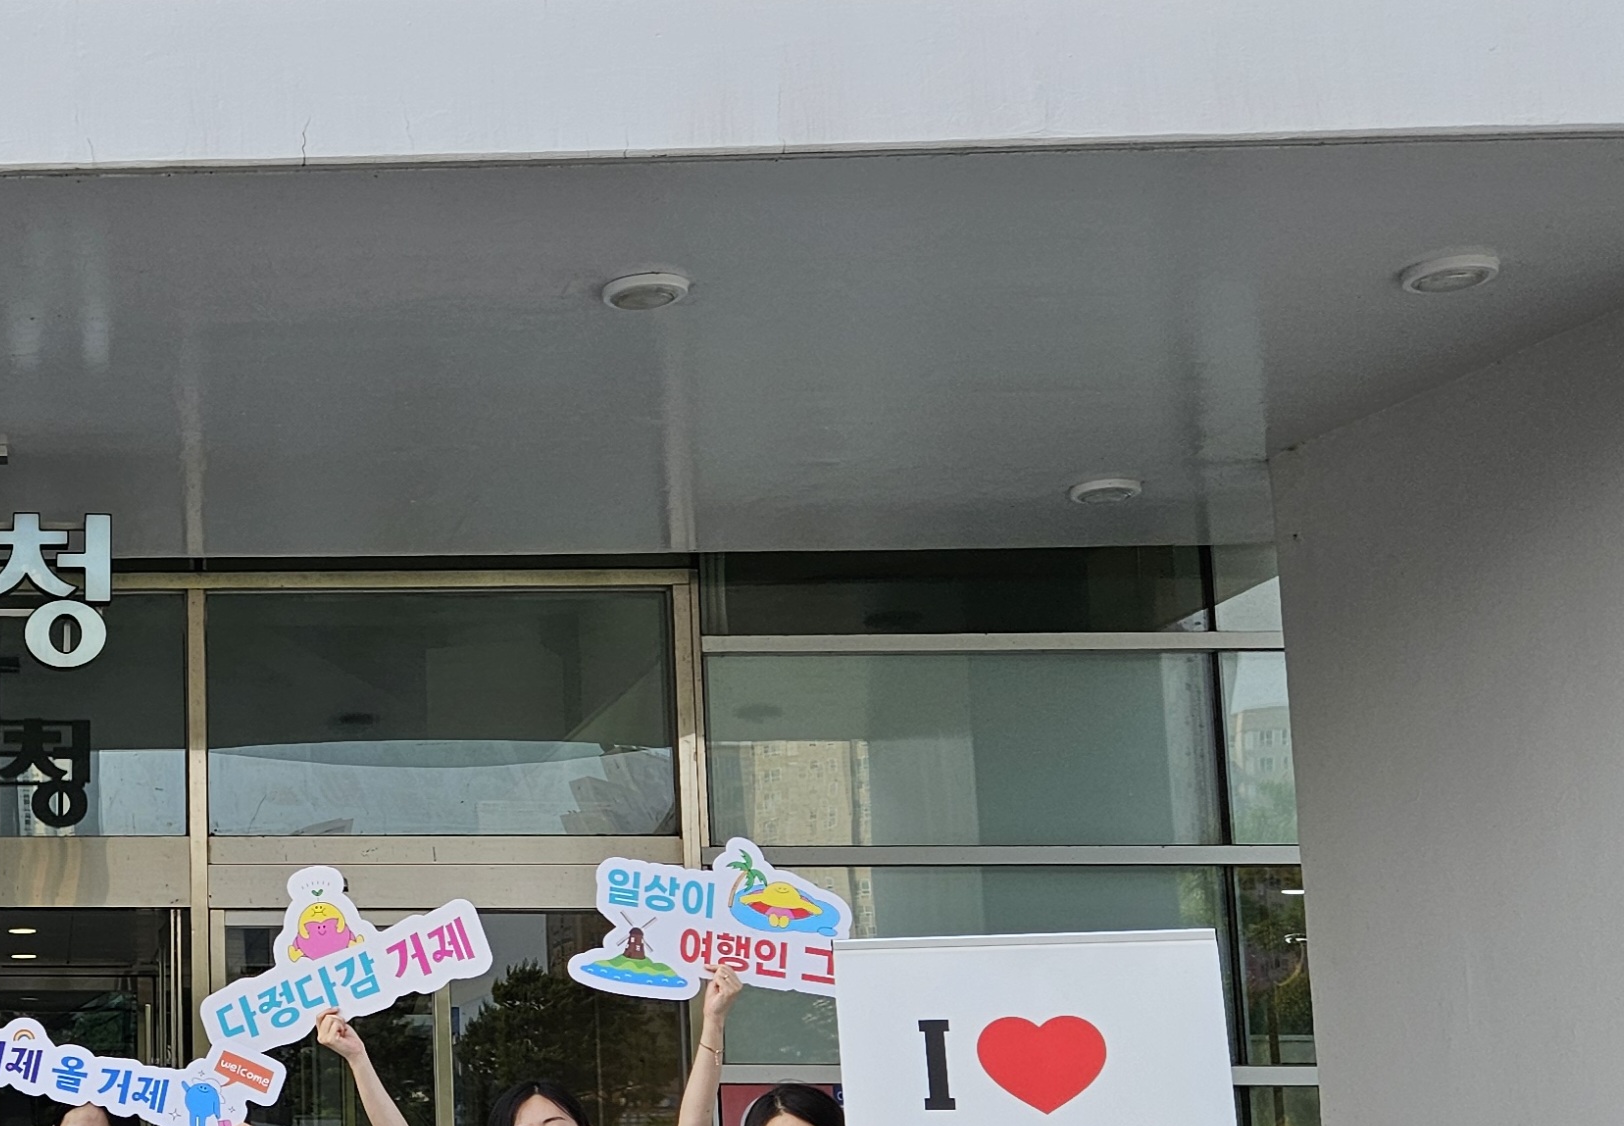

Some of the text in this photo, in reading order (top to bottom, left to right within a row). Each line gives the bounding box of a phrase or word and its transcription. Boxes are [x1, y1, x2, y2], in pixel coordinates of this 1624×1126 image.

[607, 868, 715, 918] 일상이
[216, 916, 475, 1039] 다정다감 거제
[680, 928, 835, 986] 여행인 그
[52, 1056, 88, 1093] 올
[97, 1068, 169, 1113] 거제
[219, 1057, 271, 1090] welcome
[918, 1019, 956, 1110] I
